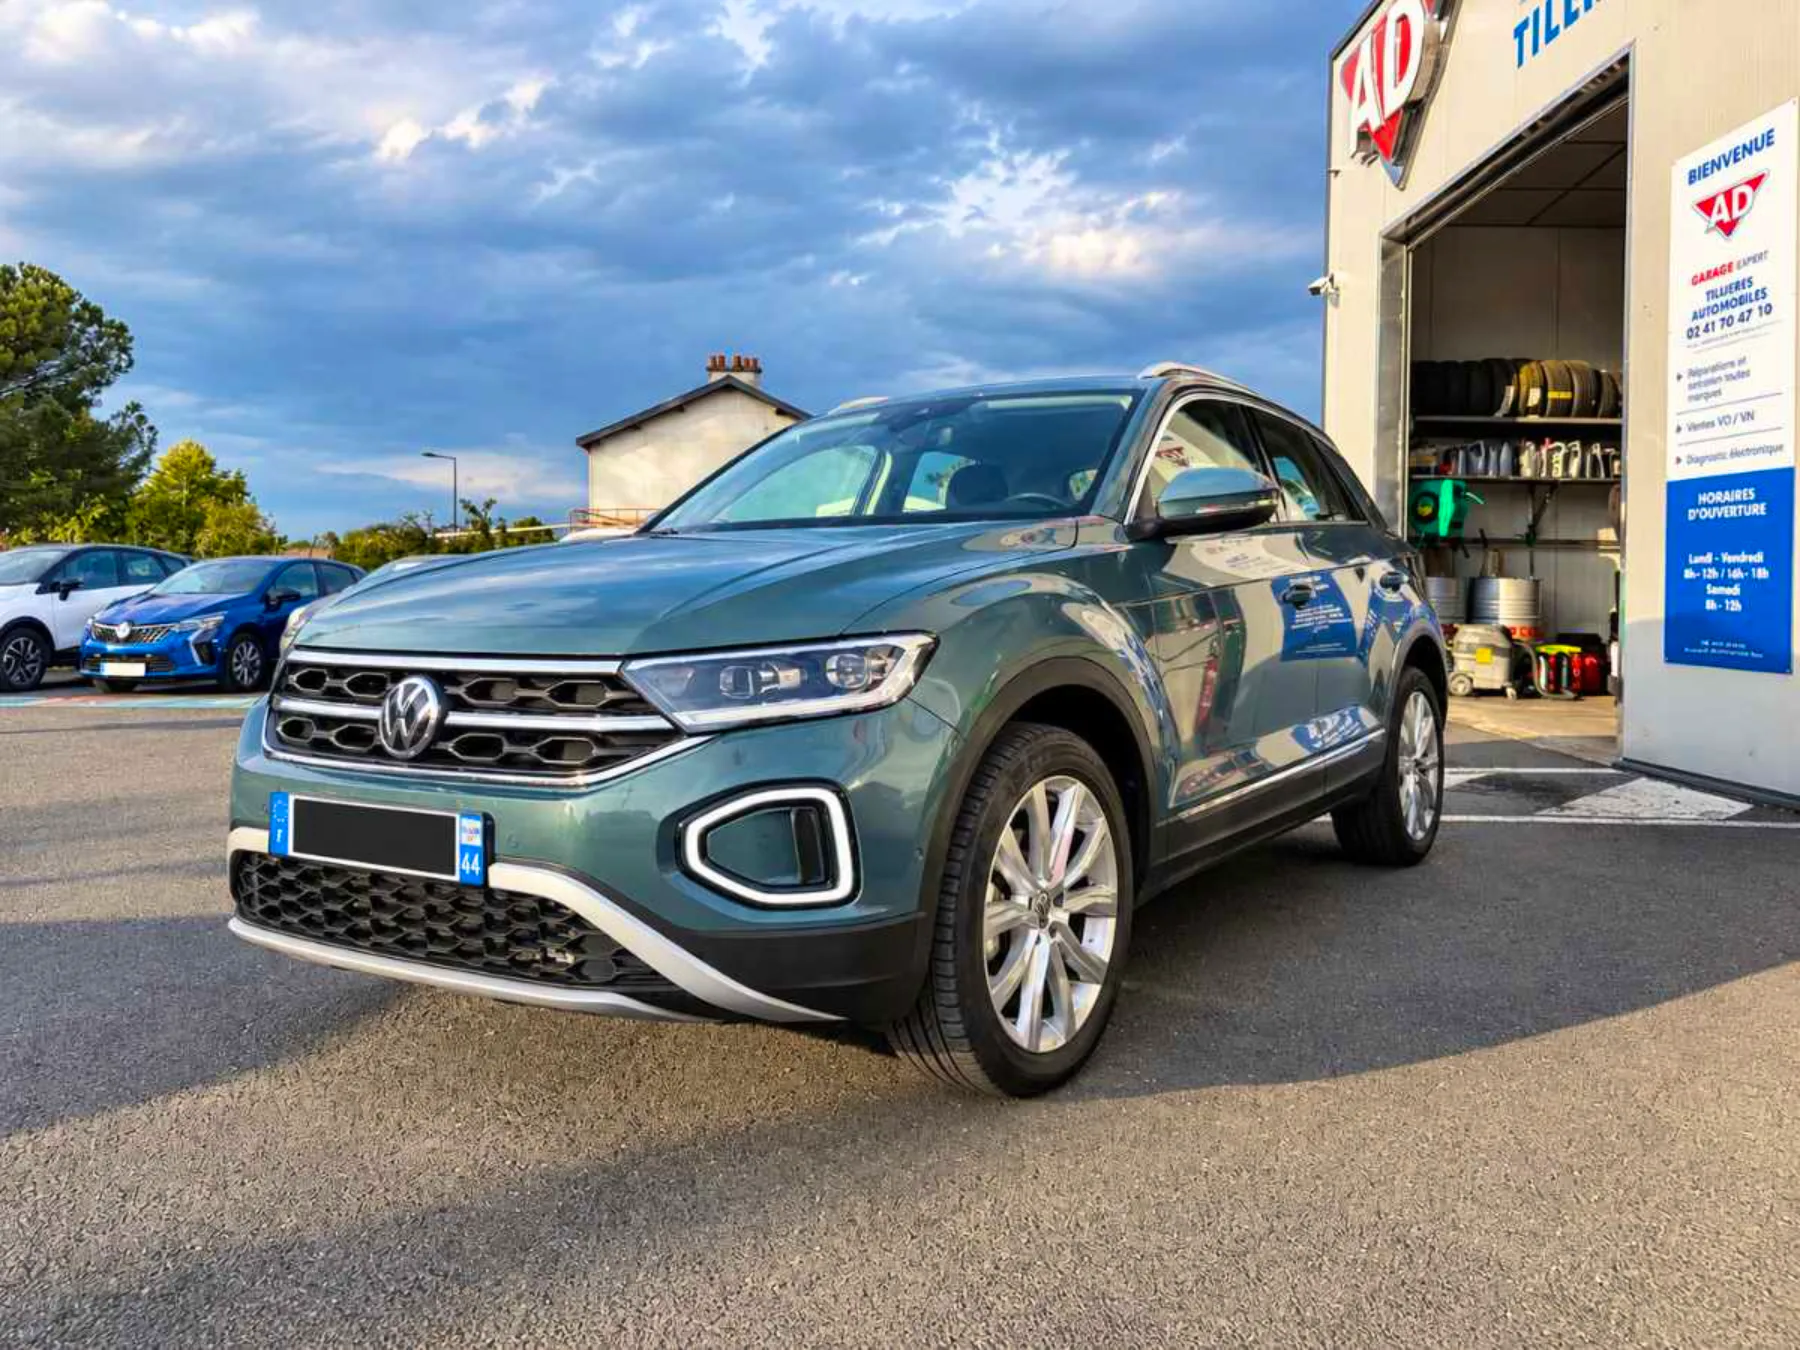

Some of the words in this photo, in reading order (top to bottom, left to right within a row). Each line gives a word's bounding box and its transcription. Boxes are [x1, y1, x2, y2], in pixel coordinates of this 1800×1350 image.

[1513, 0, 1593, 69] TILL
[1349, 0, 1424, 151] AD
[1687, 128, 1775, 186] BIENVENUE
[1691, 262, 1734, 287] GARAGE
[1691, 287, 1768, 321] AUTOMOBILES
[1686, 325, 1700, 340] 02
[1703, 321, 1715, 334] 41
[1719, 314, 1734, 330] 70
[1737, 308, 1753, 323] 47
[1758, 303, 1773, 318] 10
[1686, 420, 1715, 432] Ventes
[1740, 410, 1755, 422] VN
[1698, 487, 1756, 505] HORAIRES
[1687, 502, 1767, 521] D'OUVERTURE
[1688, 551, 1713, 565] Lundi
[1721, 550, 1764, 564] Vendredi
[1706, 583, 1741, 596] Samedi
[461, 852, 480, 877] 44
